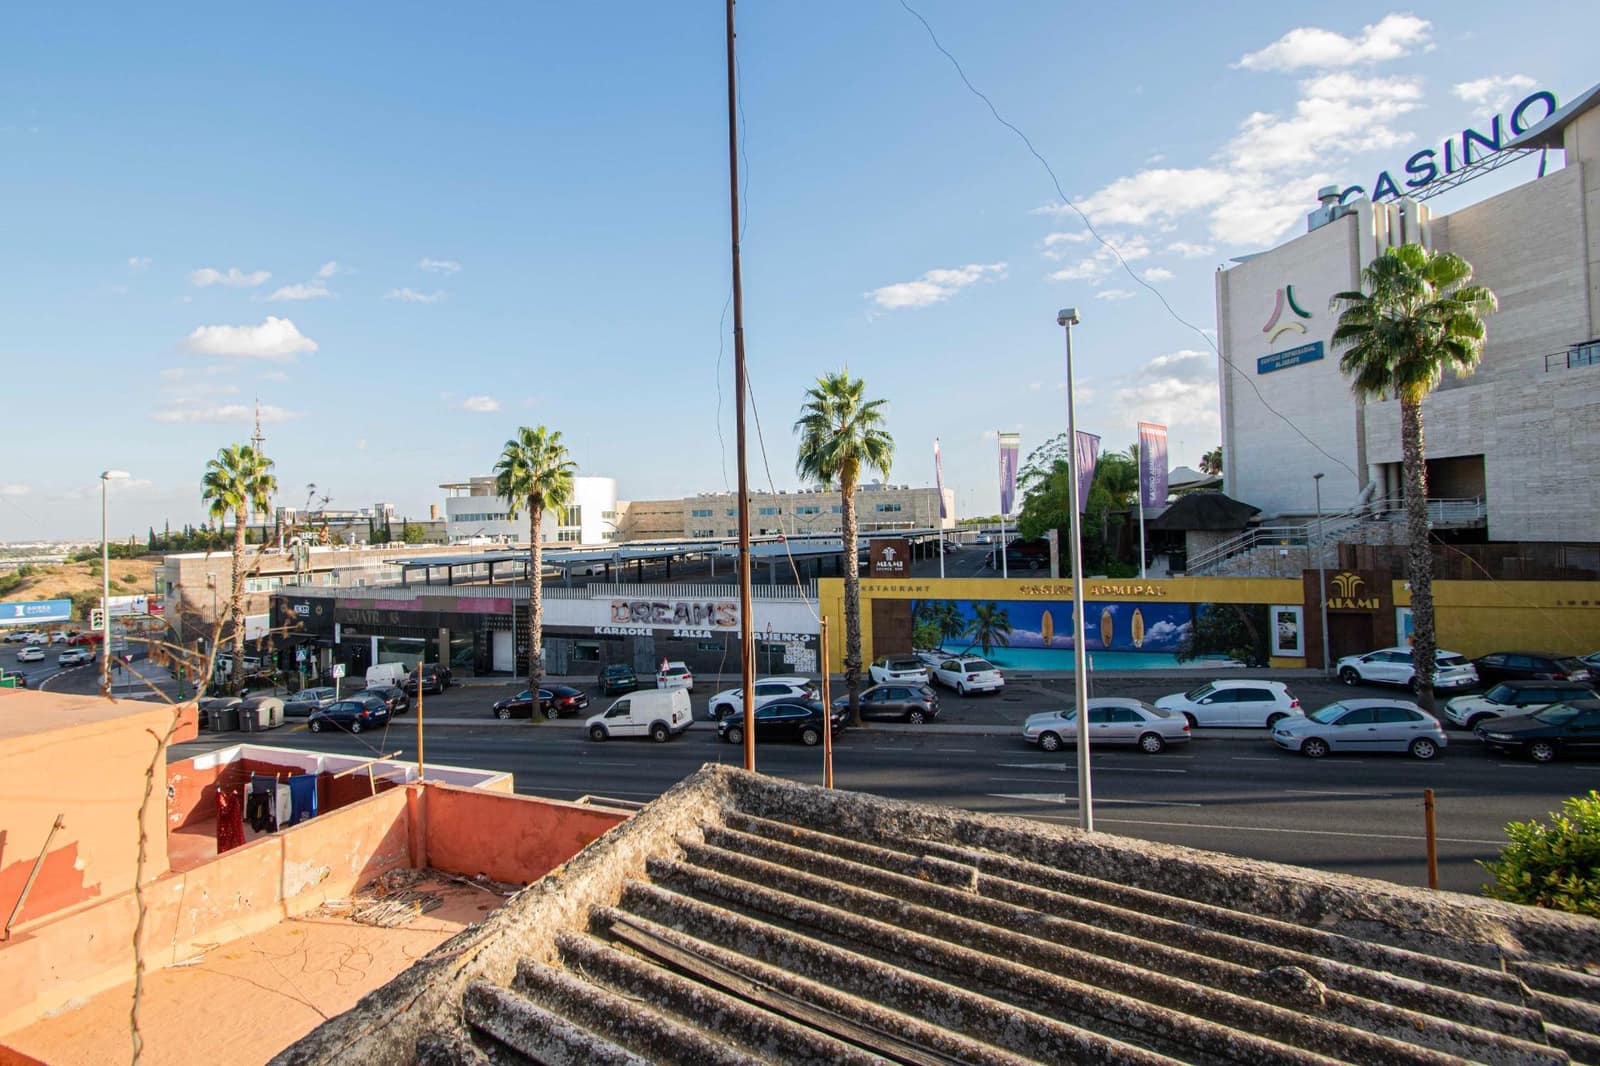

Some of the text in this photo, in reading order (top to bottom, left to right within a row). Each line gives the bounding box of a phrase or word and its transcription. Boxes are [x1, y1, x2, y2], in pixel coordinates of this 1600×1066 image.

[1338, 90, 1560, 204] CASINO
[876, 560, 904, 568] MIAMI
[861, 584, 931, 593] ESTAURANT
[1320, 597, 1380, 609] MIAMI
[611, 599, 737, 627] DREAMS
[594, 626, 654, 637] KARAOKE
[672, 629, 712, 639] SALSA
[737, 631, 811, 642] FAMENCO
